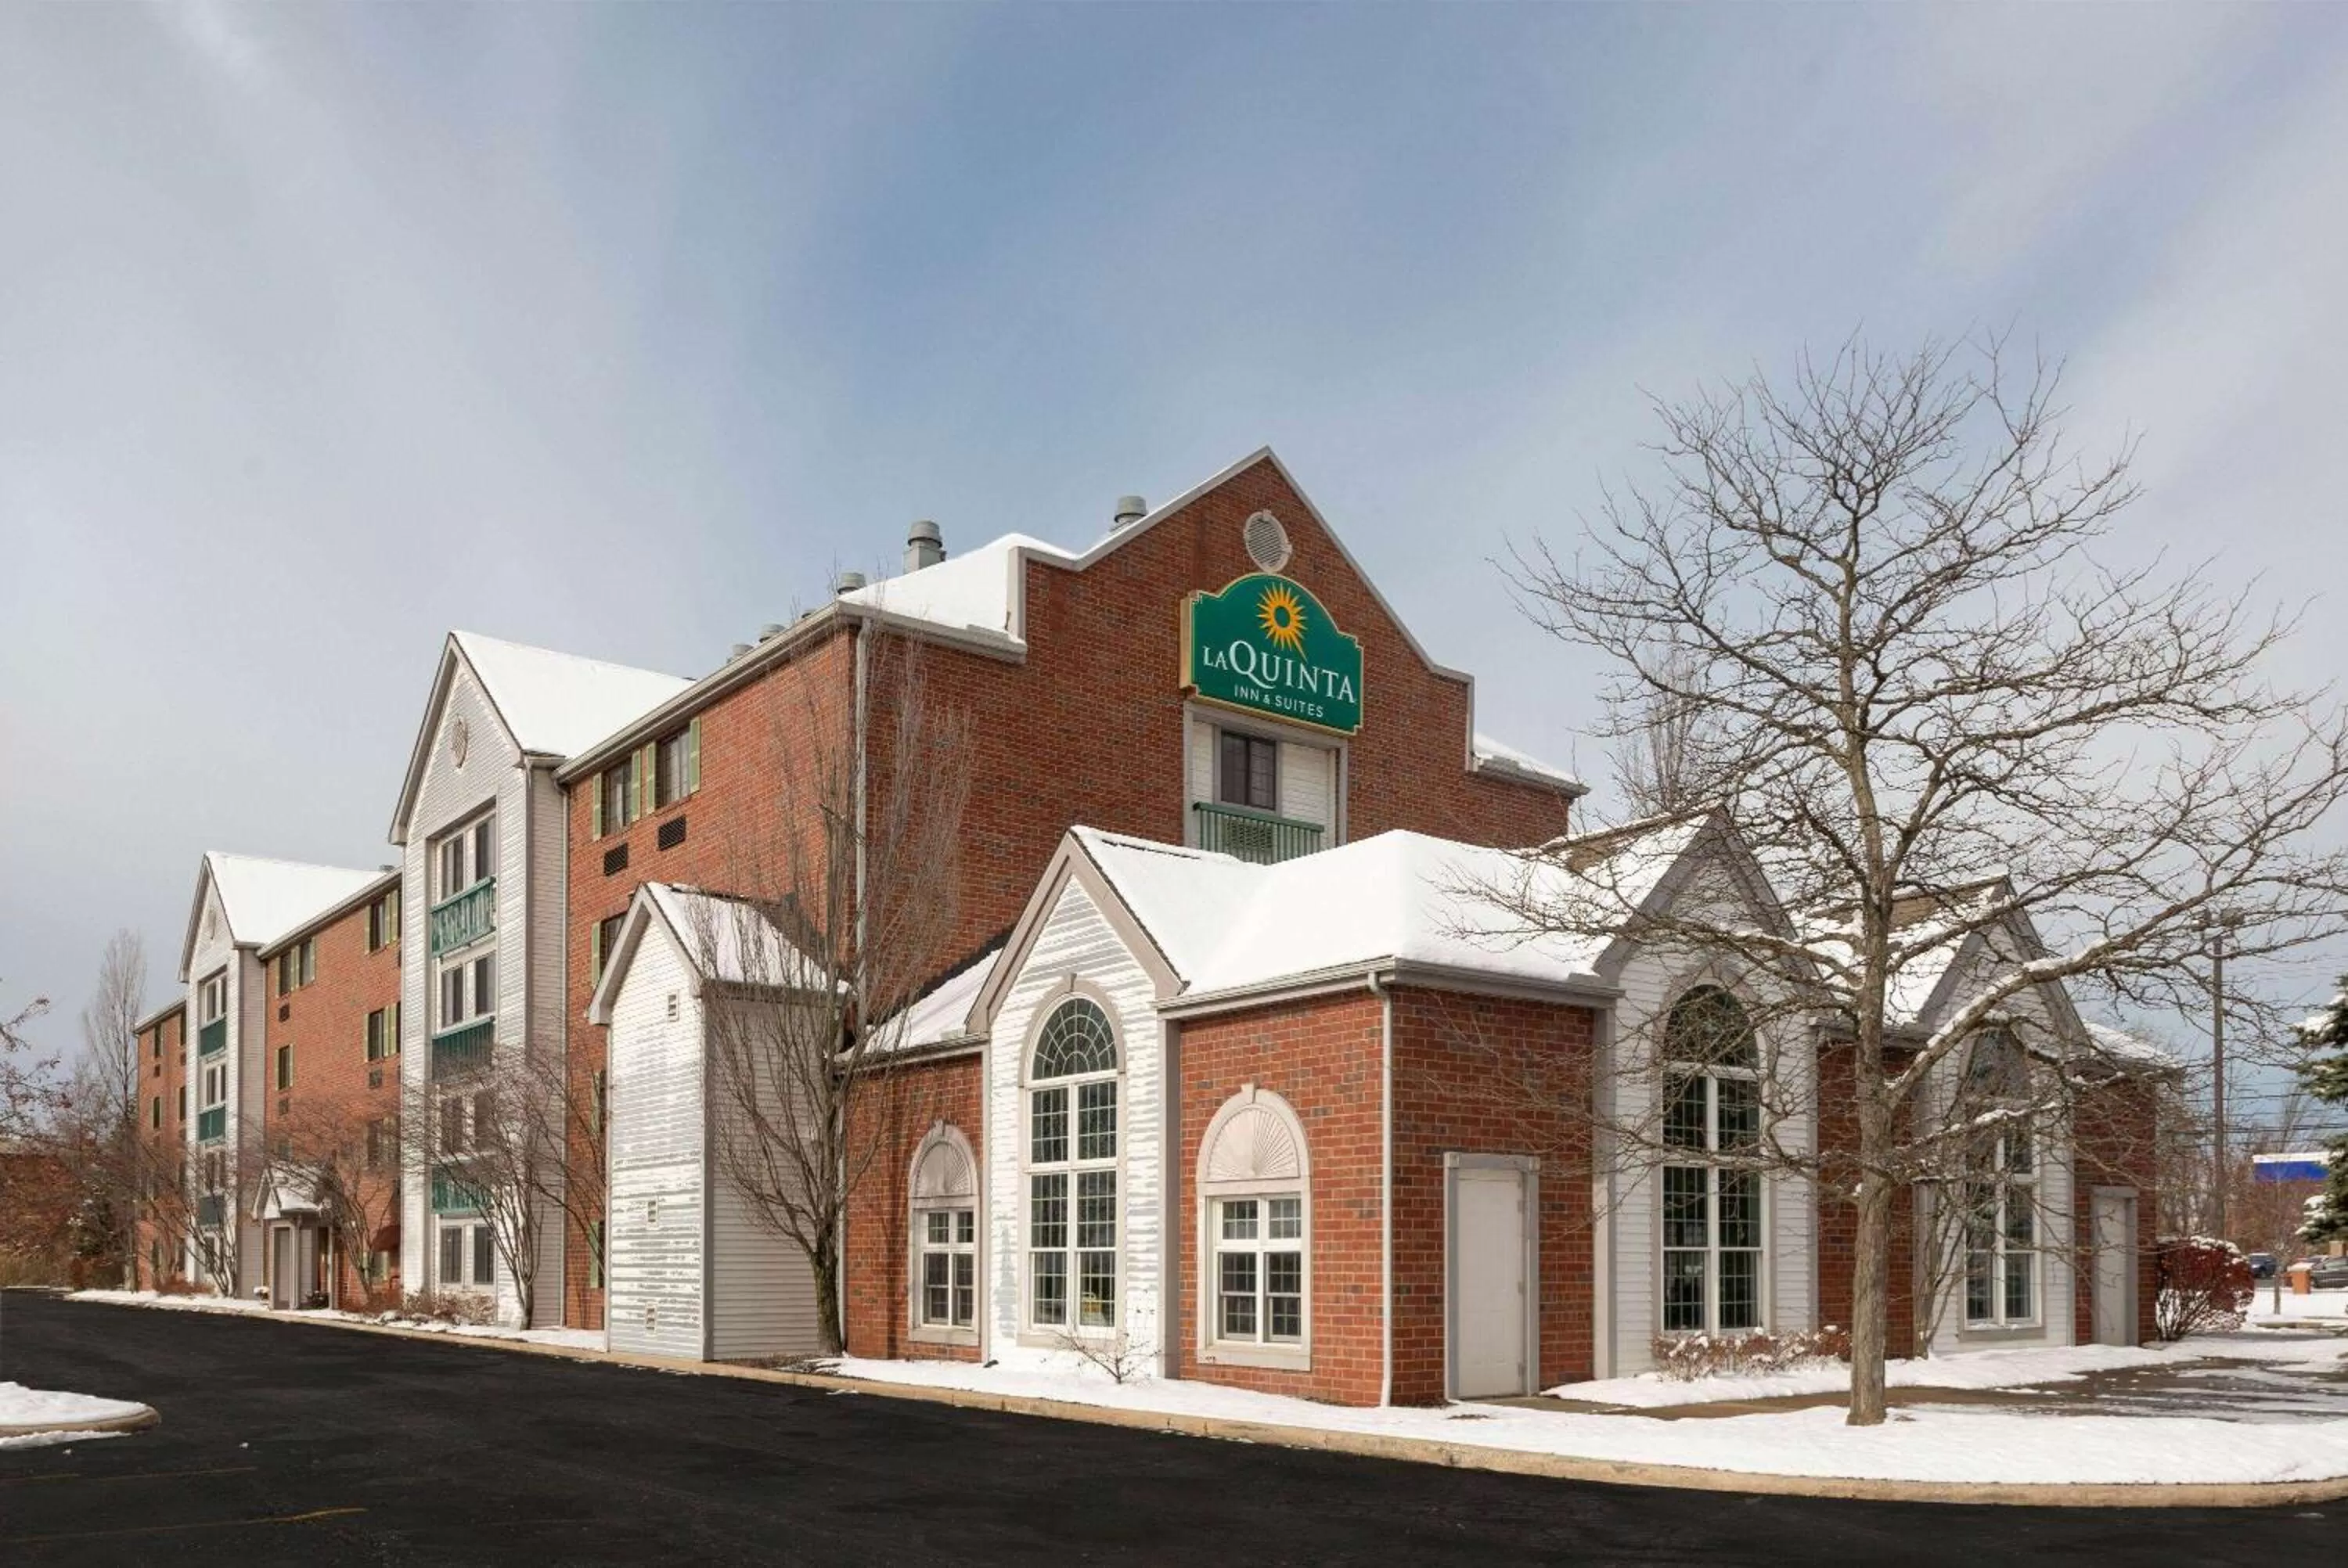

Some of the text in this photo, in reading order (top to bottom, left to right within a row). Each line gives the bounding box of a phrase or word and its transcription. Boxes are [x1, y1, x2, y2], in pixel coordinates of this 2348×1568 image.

[1202, 640, 1356, 703] LA QUINTA
[1234, 684, 1324, 718] INN & SUITES
